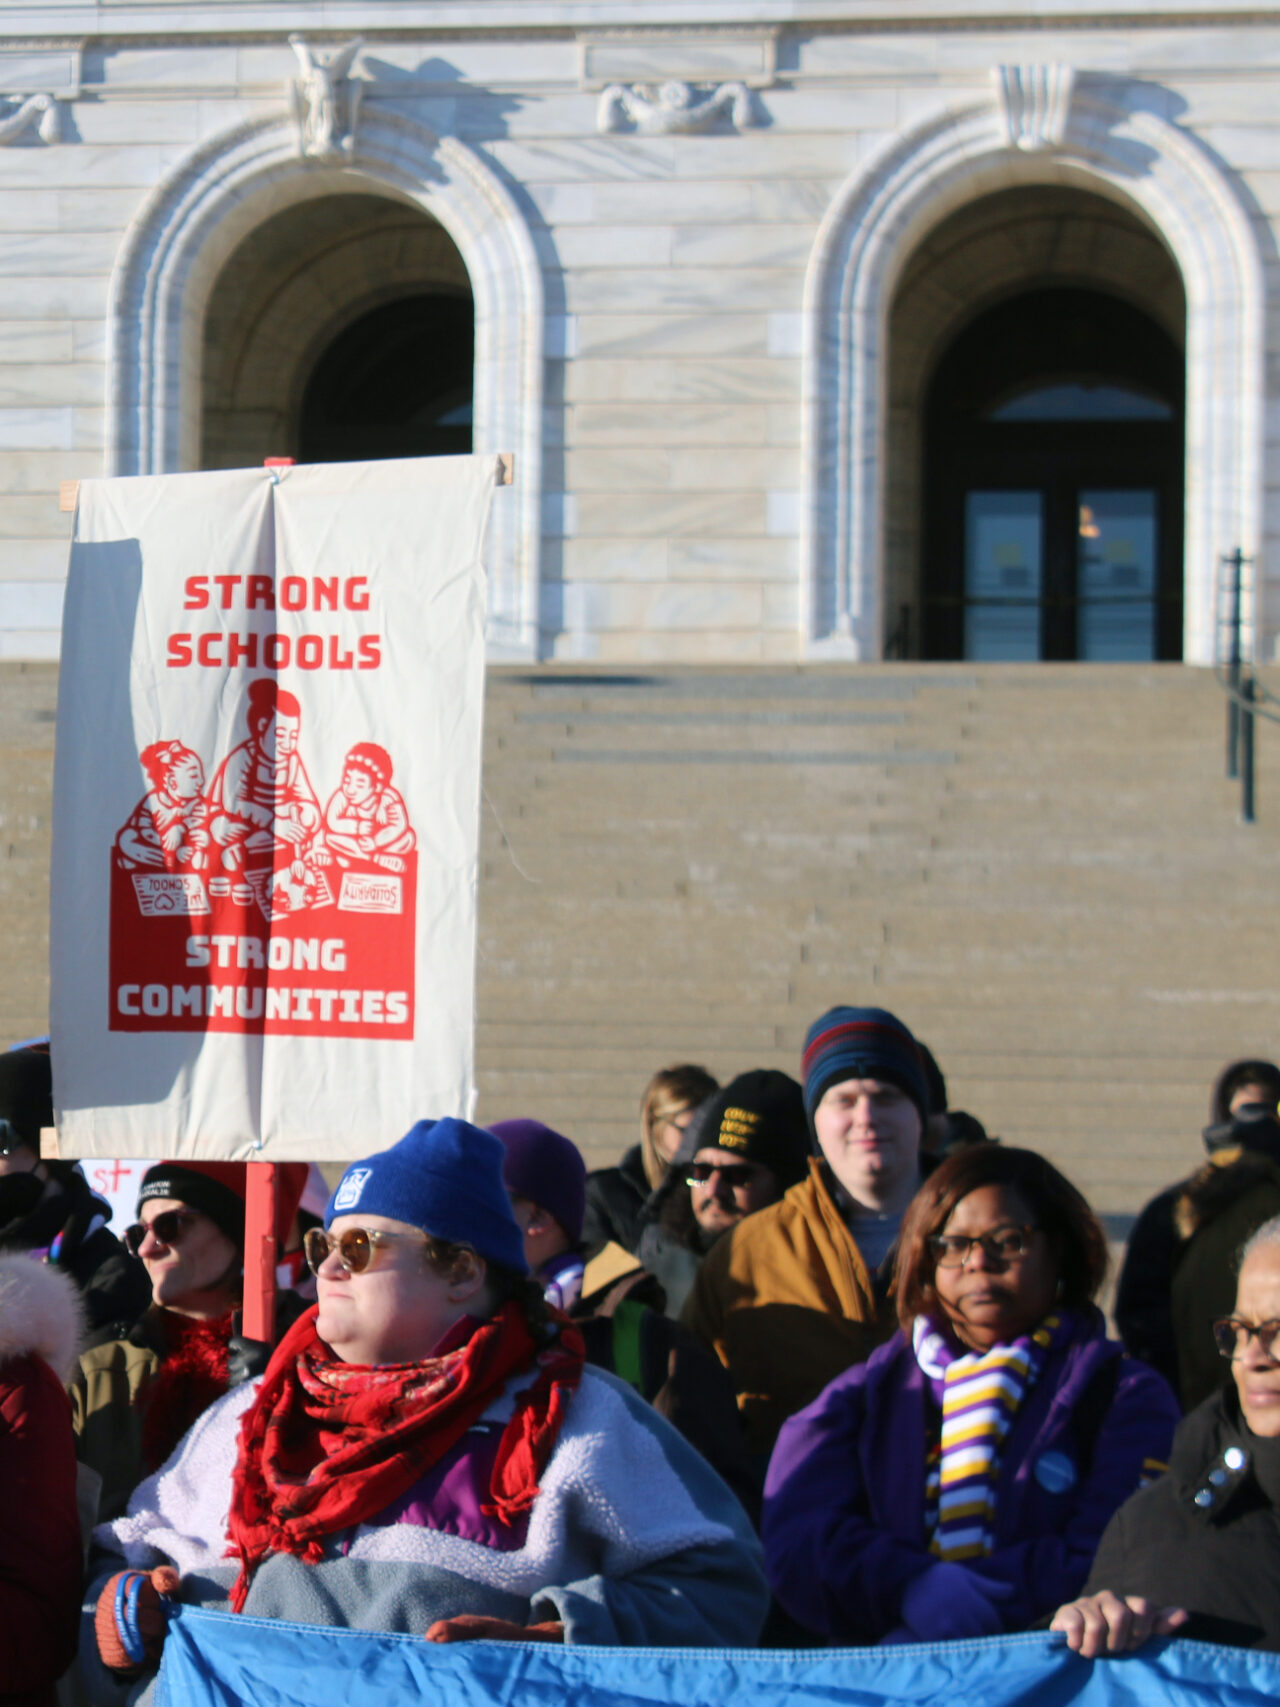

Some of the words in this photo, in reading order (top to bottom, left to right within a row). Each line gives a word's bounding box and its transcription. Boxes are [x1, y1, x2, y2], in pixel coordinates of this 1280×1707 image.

[183, 575, 370, 611] STRONG
[166, 633, 381, 670] SCHOOLS
[185, 935, 347, 972] STRONG
[117, 984, 408, 1024] COMMUNITIES
